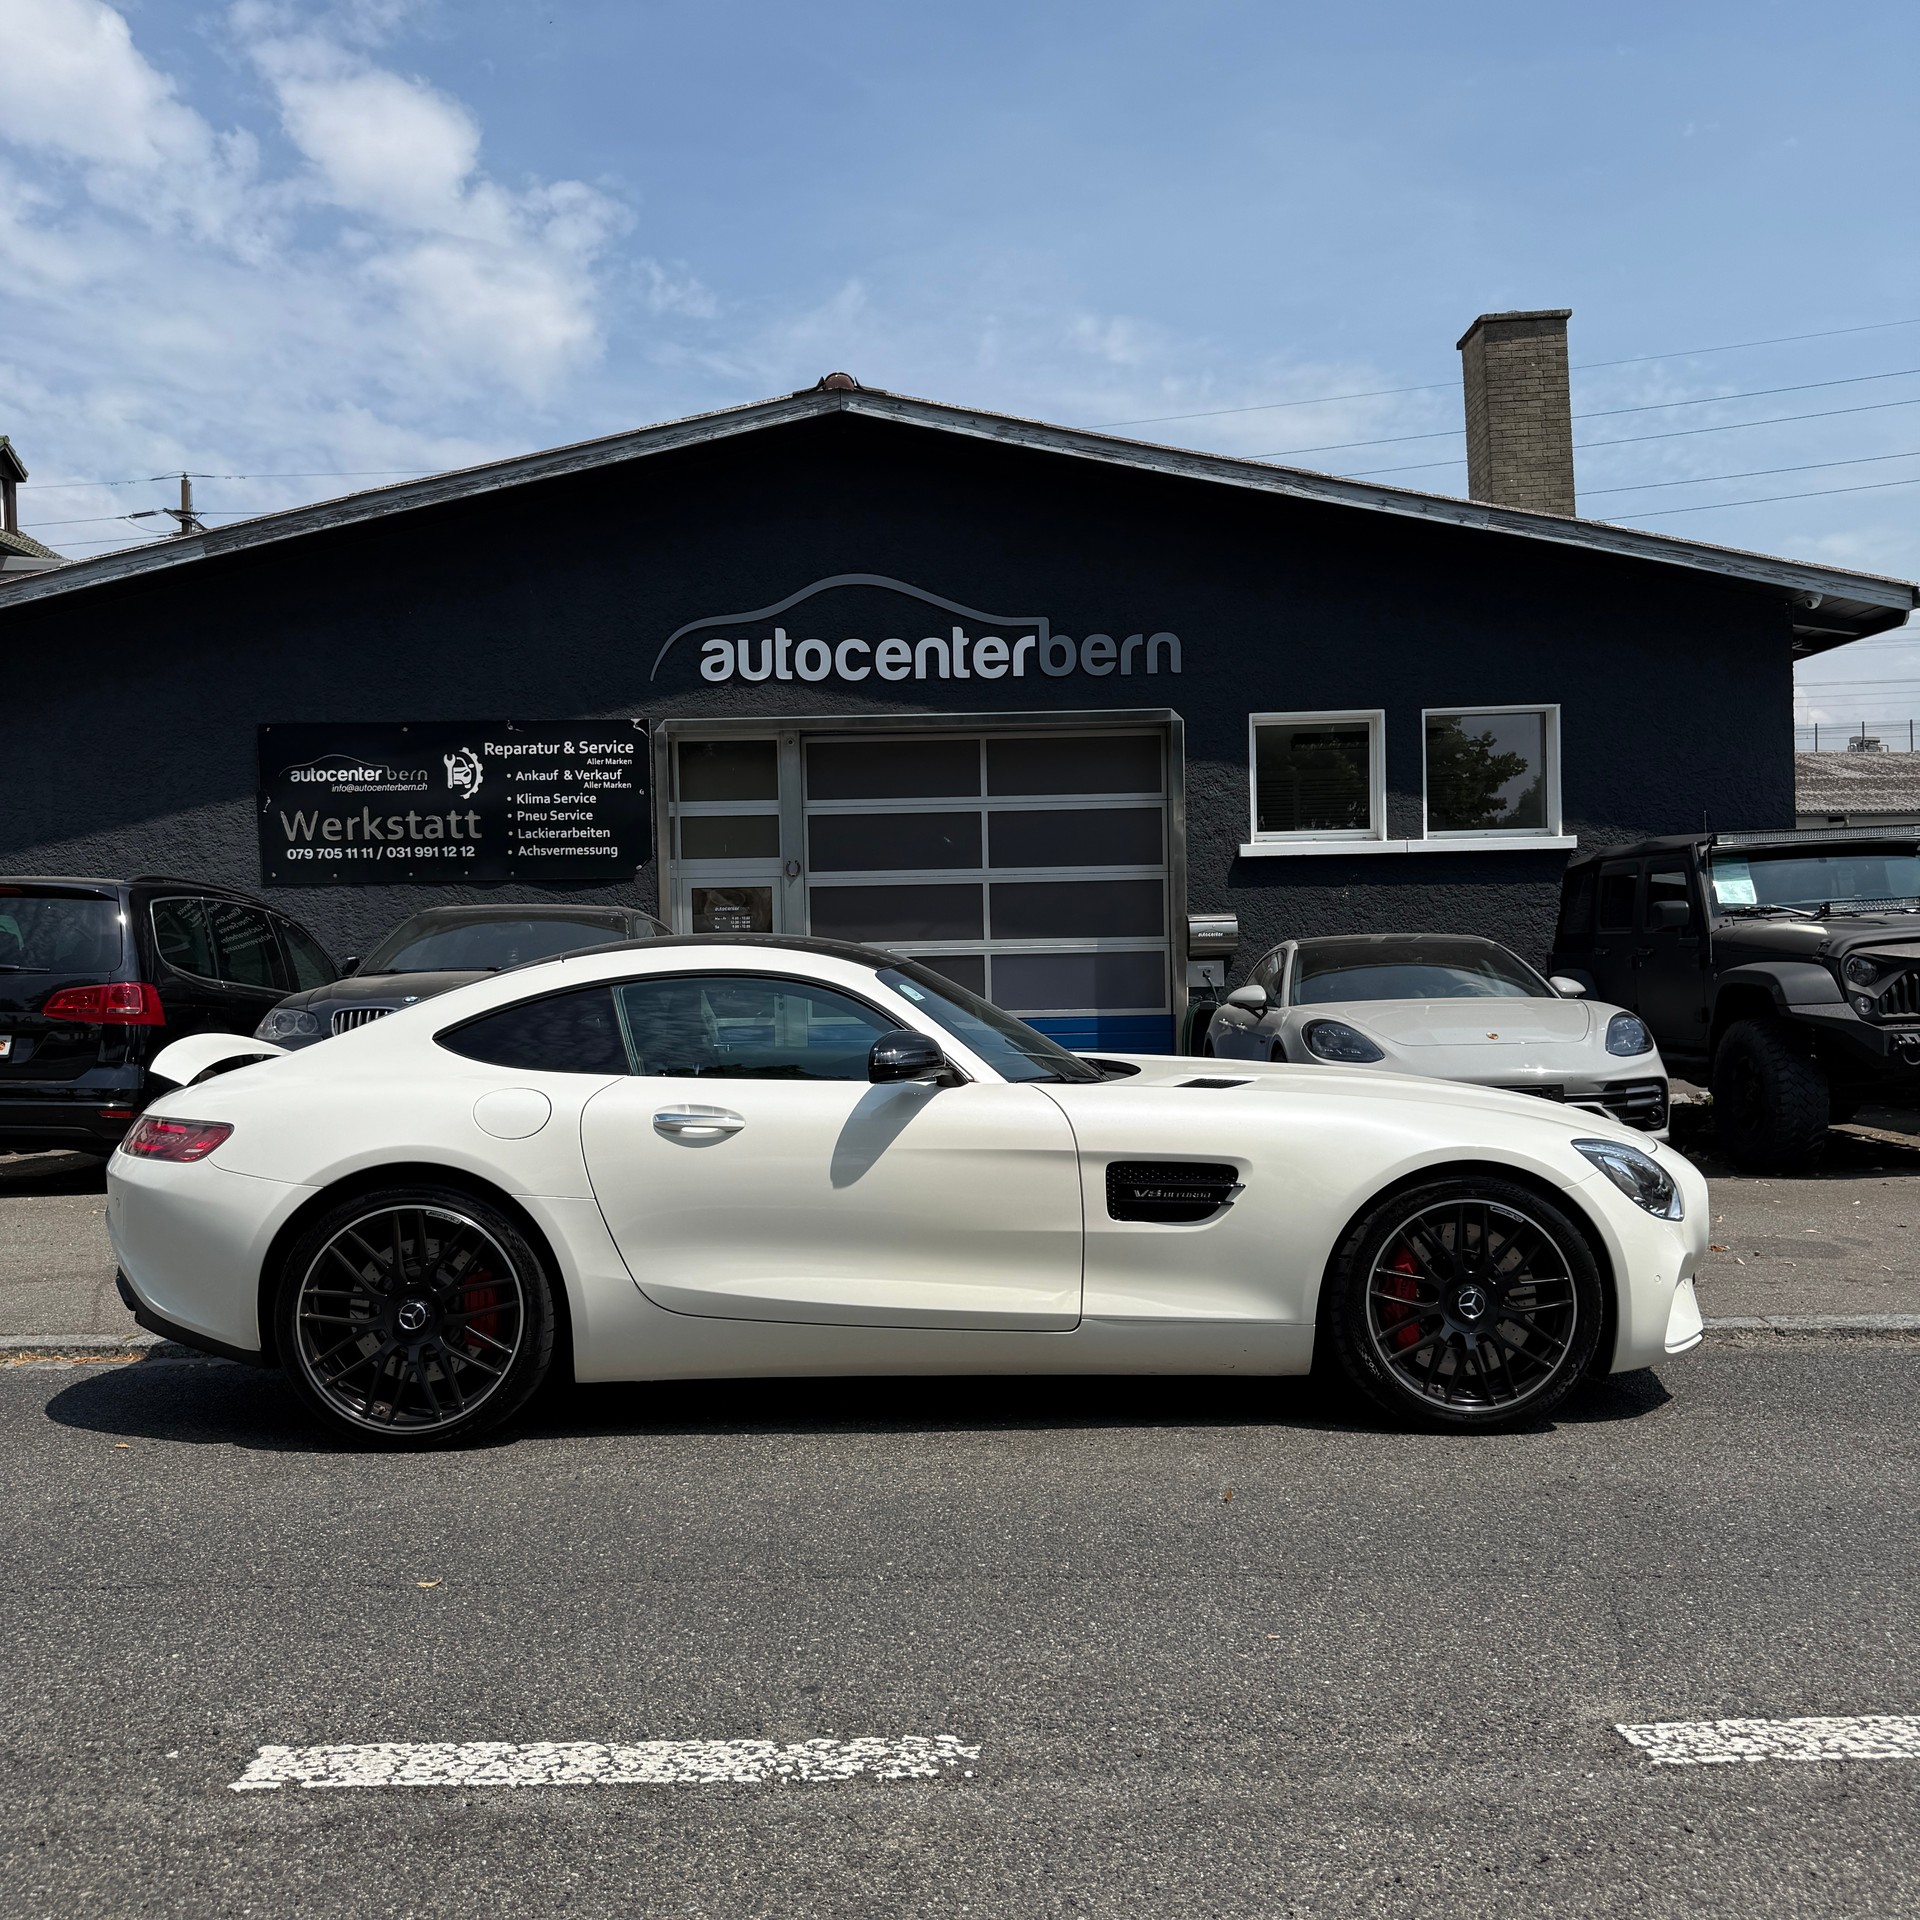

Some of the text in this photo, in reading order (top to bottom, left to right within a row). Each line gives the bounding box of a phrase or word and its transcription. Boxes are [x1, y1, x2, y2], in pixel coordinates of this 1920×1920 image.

[484, 740, 635, 759] Reparatur & Service
[586, 758, 633, 766] Aller Marken
[515, 768, 623, 781] Ankauf & Verkauf
[331, 782, 428, 793] info@autocenterbern.ch
[583, 781, 632, 789] Aller Marken
[516, 792, 597, 804] Klima Service
[517, 809, 594, 821] Pneu Service
[280, 806, 483, 841] Werkstatt
[518, 826, 611, 839] Lackierarbeiten
[287, 846, 475, 861] 079 705 11 11 / 031 991 12 12
[518, 845, 619, 858] Achsvermessung
